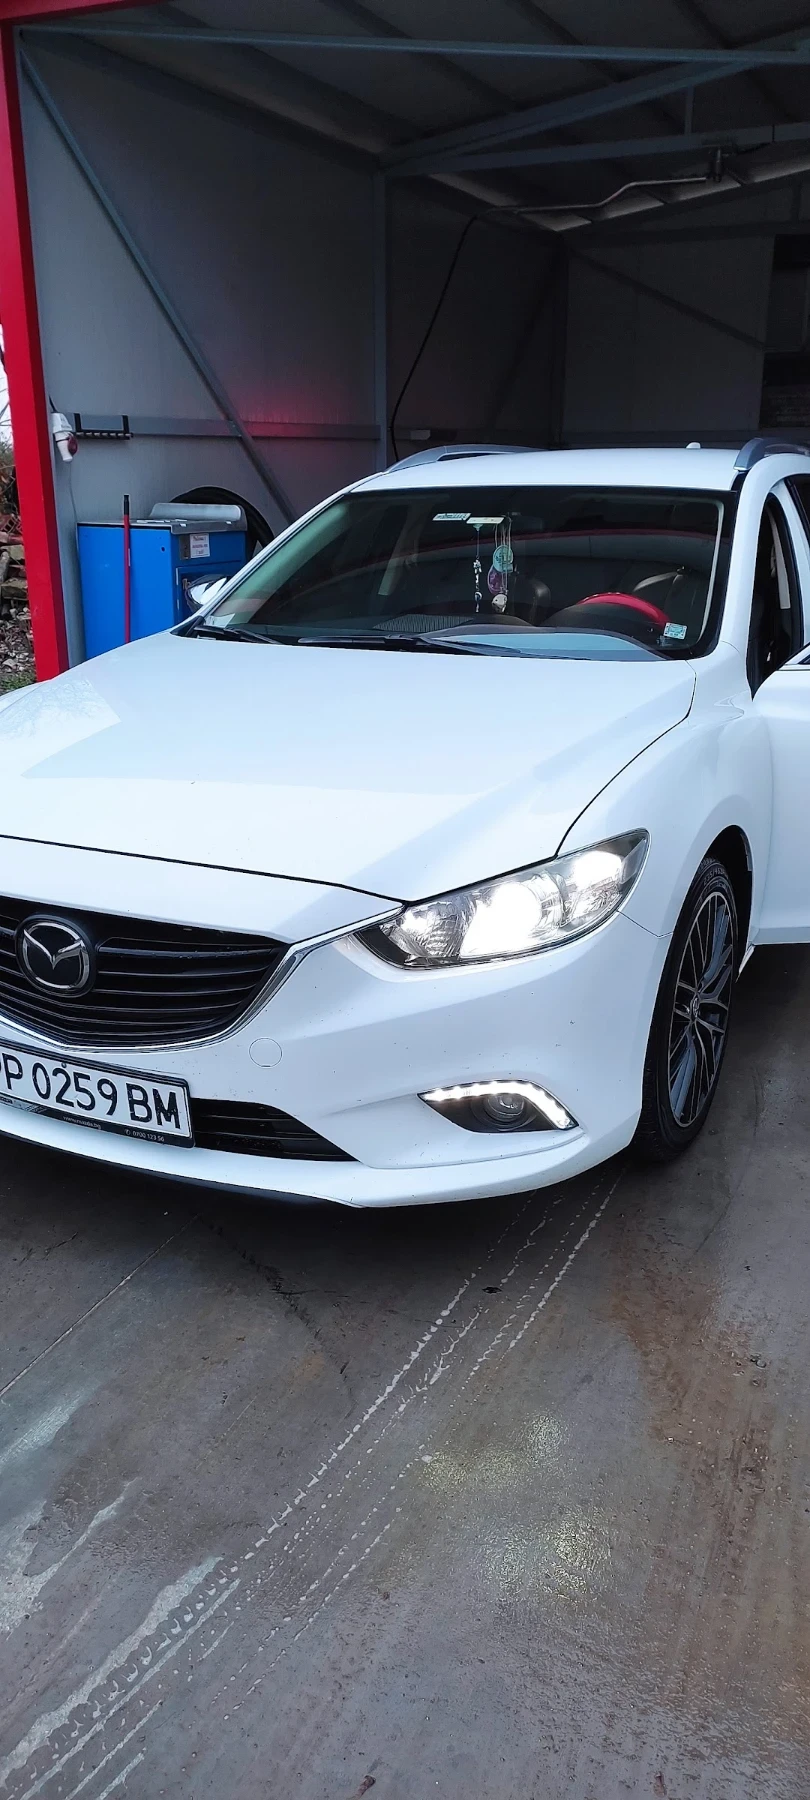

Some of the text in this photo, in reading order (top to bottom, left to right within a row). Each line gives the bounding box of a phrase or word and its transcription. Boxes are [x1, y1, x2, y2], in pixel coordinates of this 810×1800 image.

[0, 1053, 181, 1130] P 0259 BM
